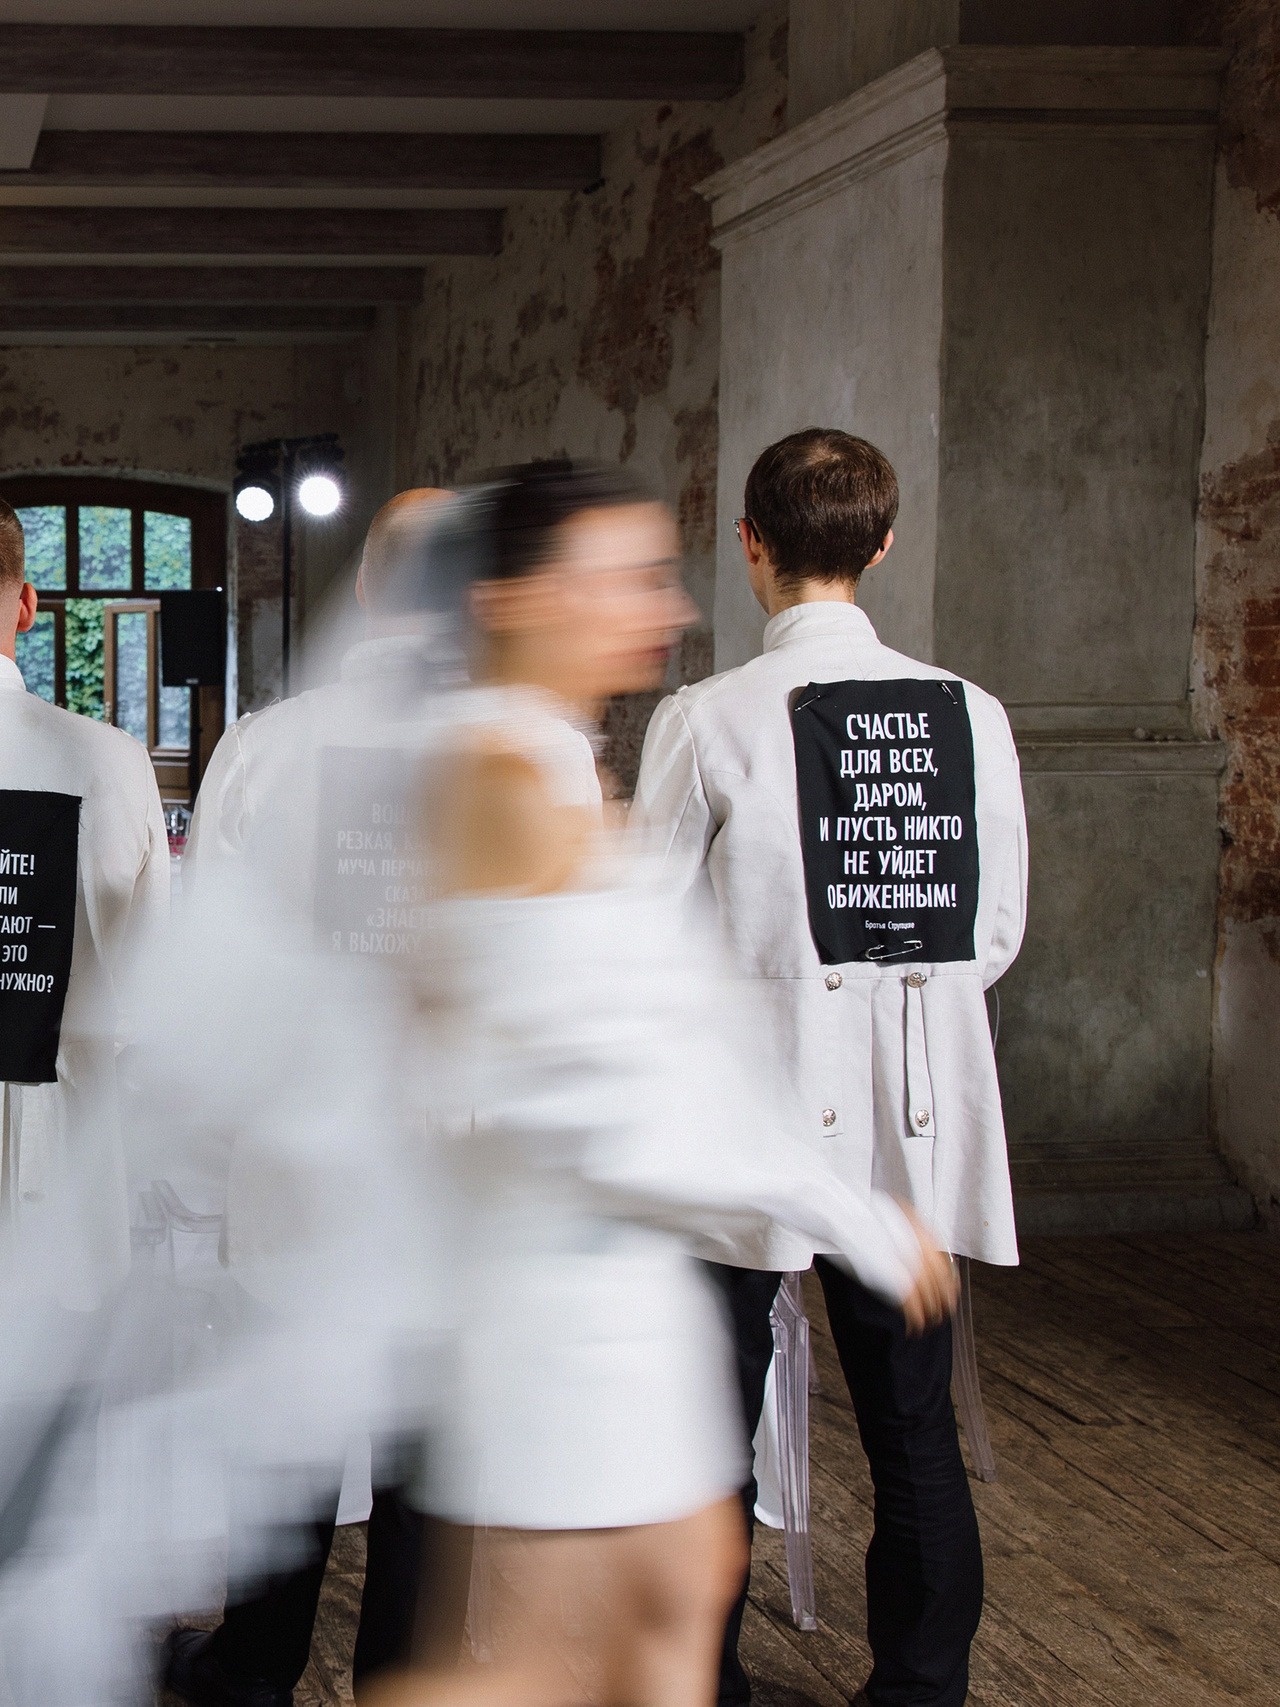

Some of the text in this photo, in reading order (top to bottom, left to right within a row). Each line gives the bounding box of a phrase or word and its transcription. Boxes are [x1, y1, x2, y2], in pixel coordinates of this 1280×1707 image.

[847, 713, 930, 740] СЧАСТЬЕ
[840, 748, 938, 778] ДЛЯ ВСЕХ,
[854, 782, 927, 812] ДАРОМ,
[820, 815, 962, 841] И ПУСТЬ НИКТО
[337, 859, 376, 876] МУЧА
[844, 845, 937, 879] НЕ УЙДЕТ
[828, 884, 956, 909] ОБИЖЕННЫМ!
[865, 920, 886, 930] Братья
[2, 945, 27, 962] ЭТО
[332, 931, 342, 952] Я
